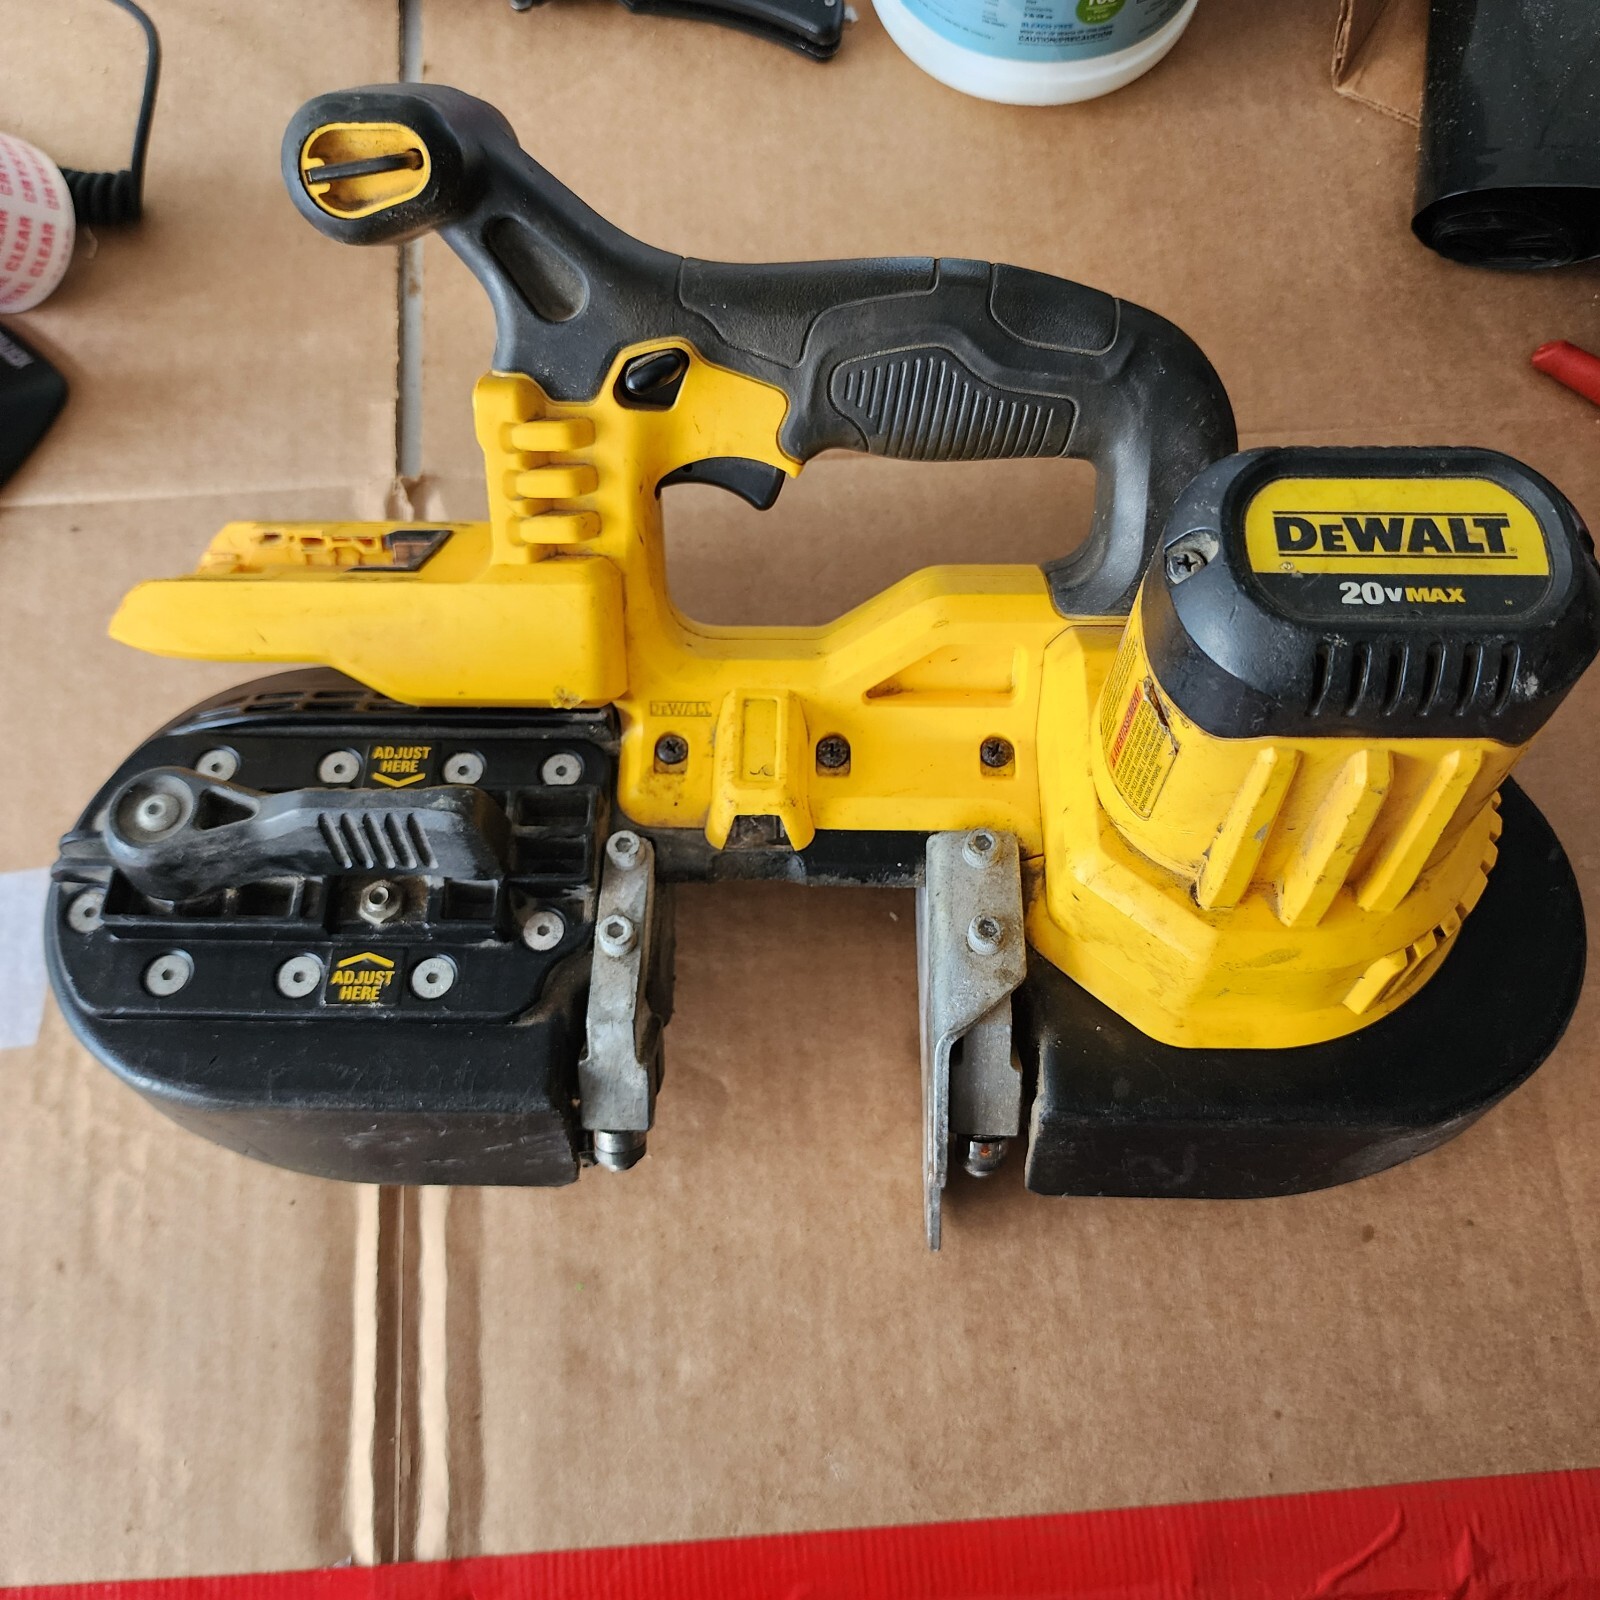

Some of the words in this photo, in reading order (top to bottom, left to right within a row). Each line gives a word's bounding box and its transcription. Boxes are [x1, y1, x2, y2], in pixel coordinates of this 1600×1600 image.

[4, 216, 32, 272] CLEAR
[28, 223, 55, 278] CLEAR
[1273, 516, 1511, 554] DEWALT
[1405, 587, 1467, 604] MAX
[371, 745, 432, 760] ADJUST
[379, 760, 419, 774] HERE
[330, 970, 396, 985] ADJUST
[338, 985, 381, 1001] HERE
